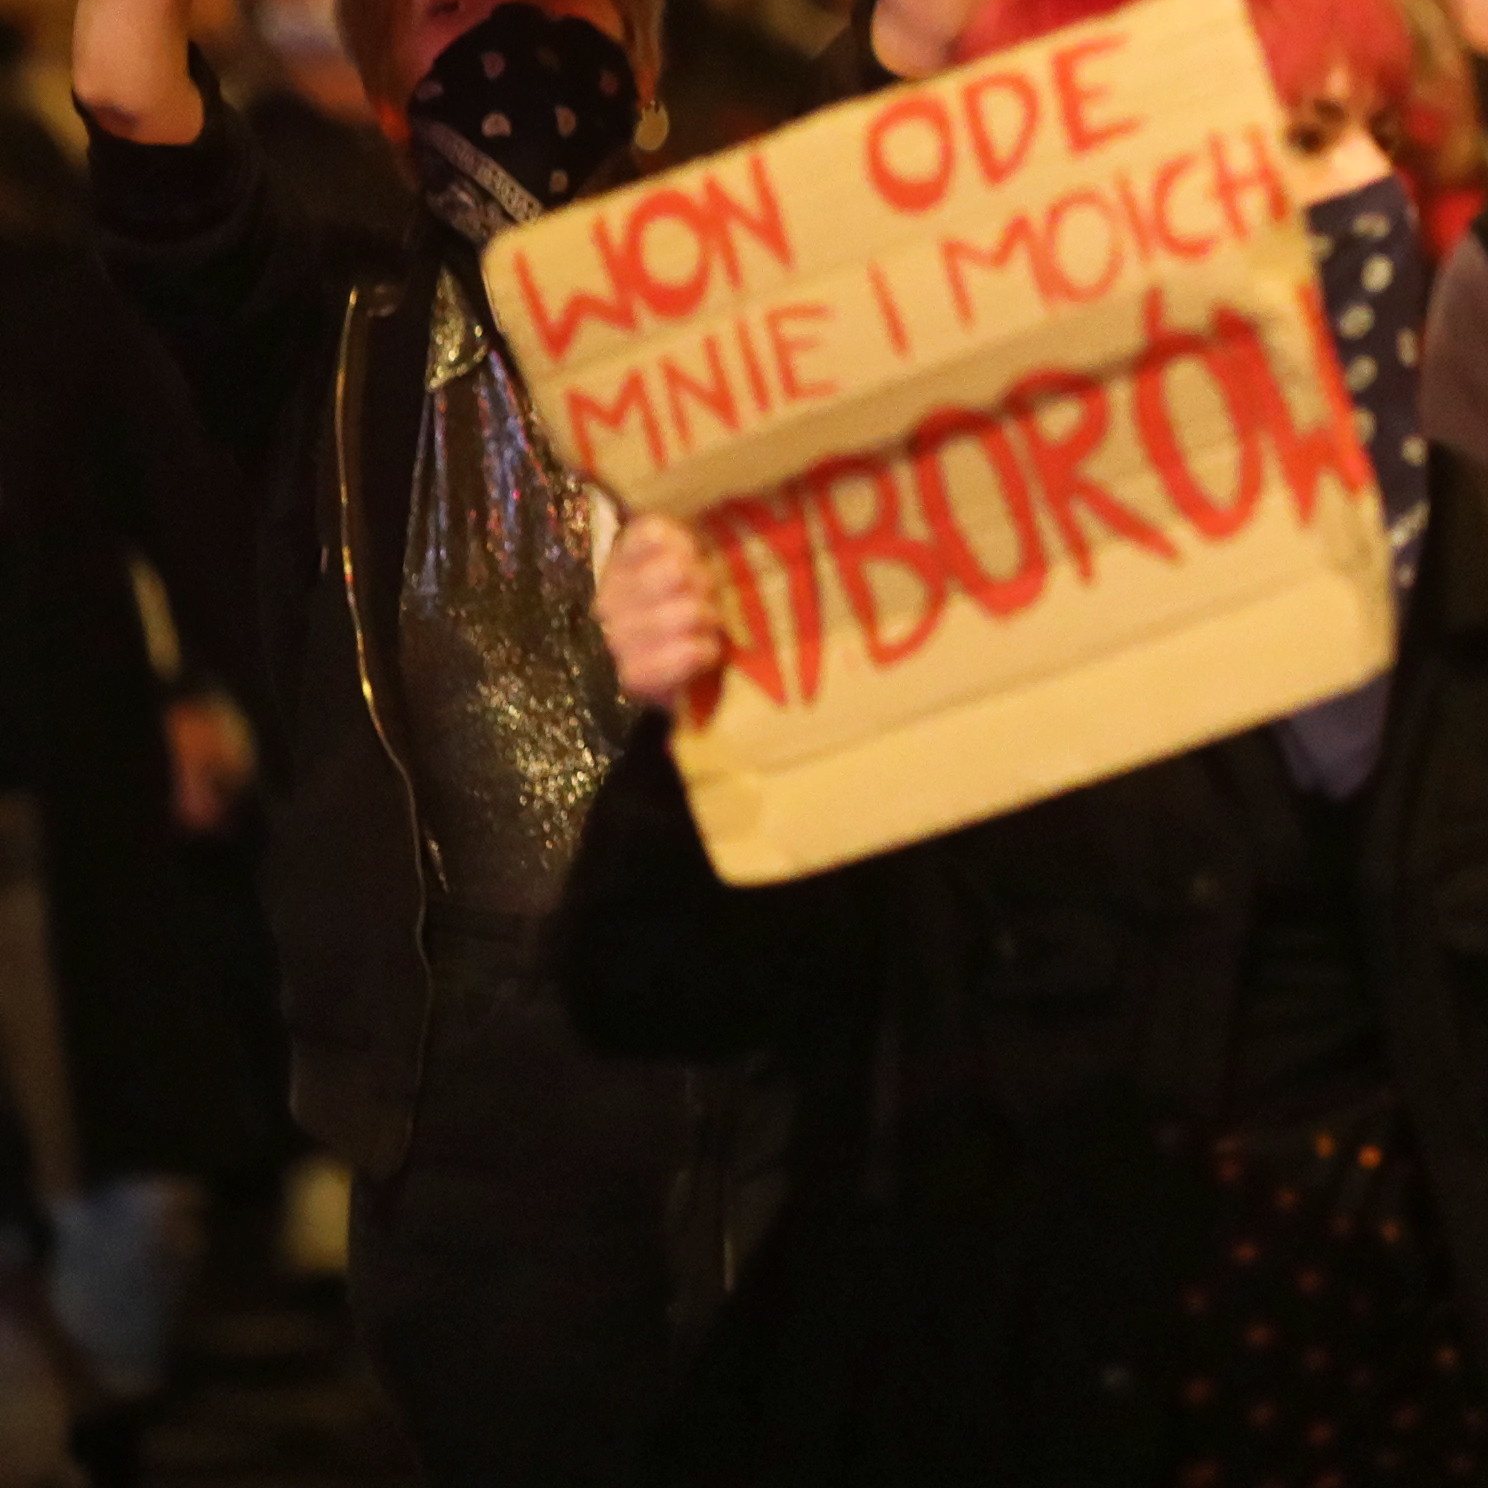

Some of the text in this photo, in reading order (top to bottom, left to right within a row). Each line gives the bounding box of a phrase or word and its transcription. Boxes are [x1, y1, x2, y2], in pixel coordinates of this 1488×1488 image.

[512, 29, 1146, 366] WON ODE
[562, 125, 1293, 474] MNIE I MOICH
